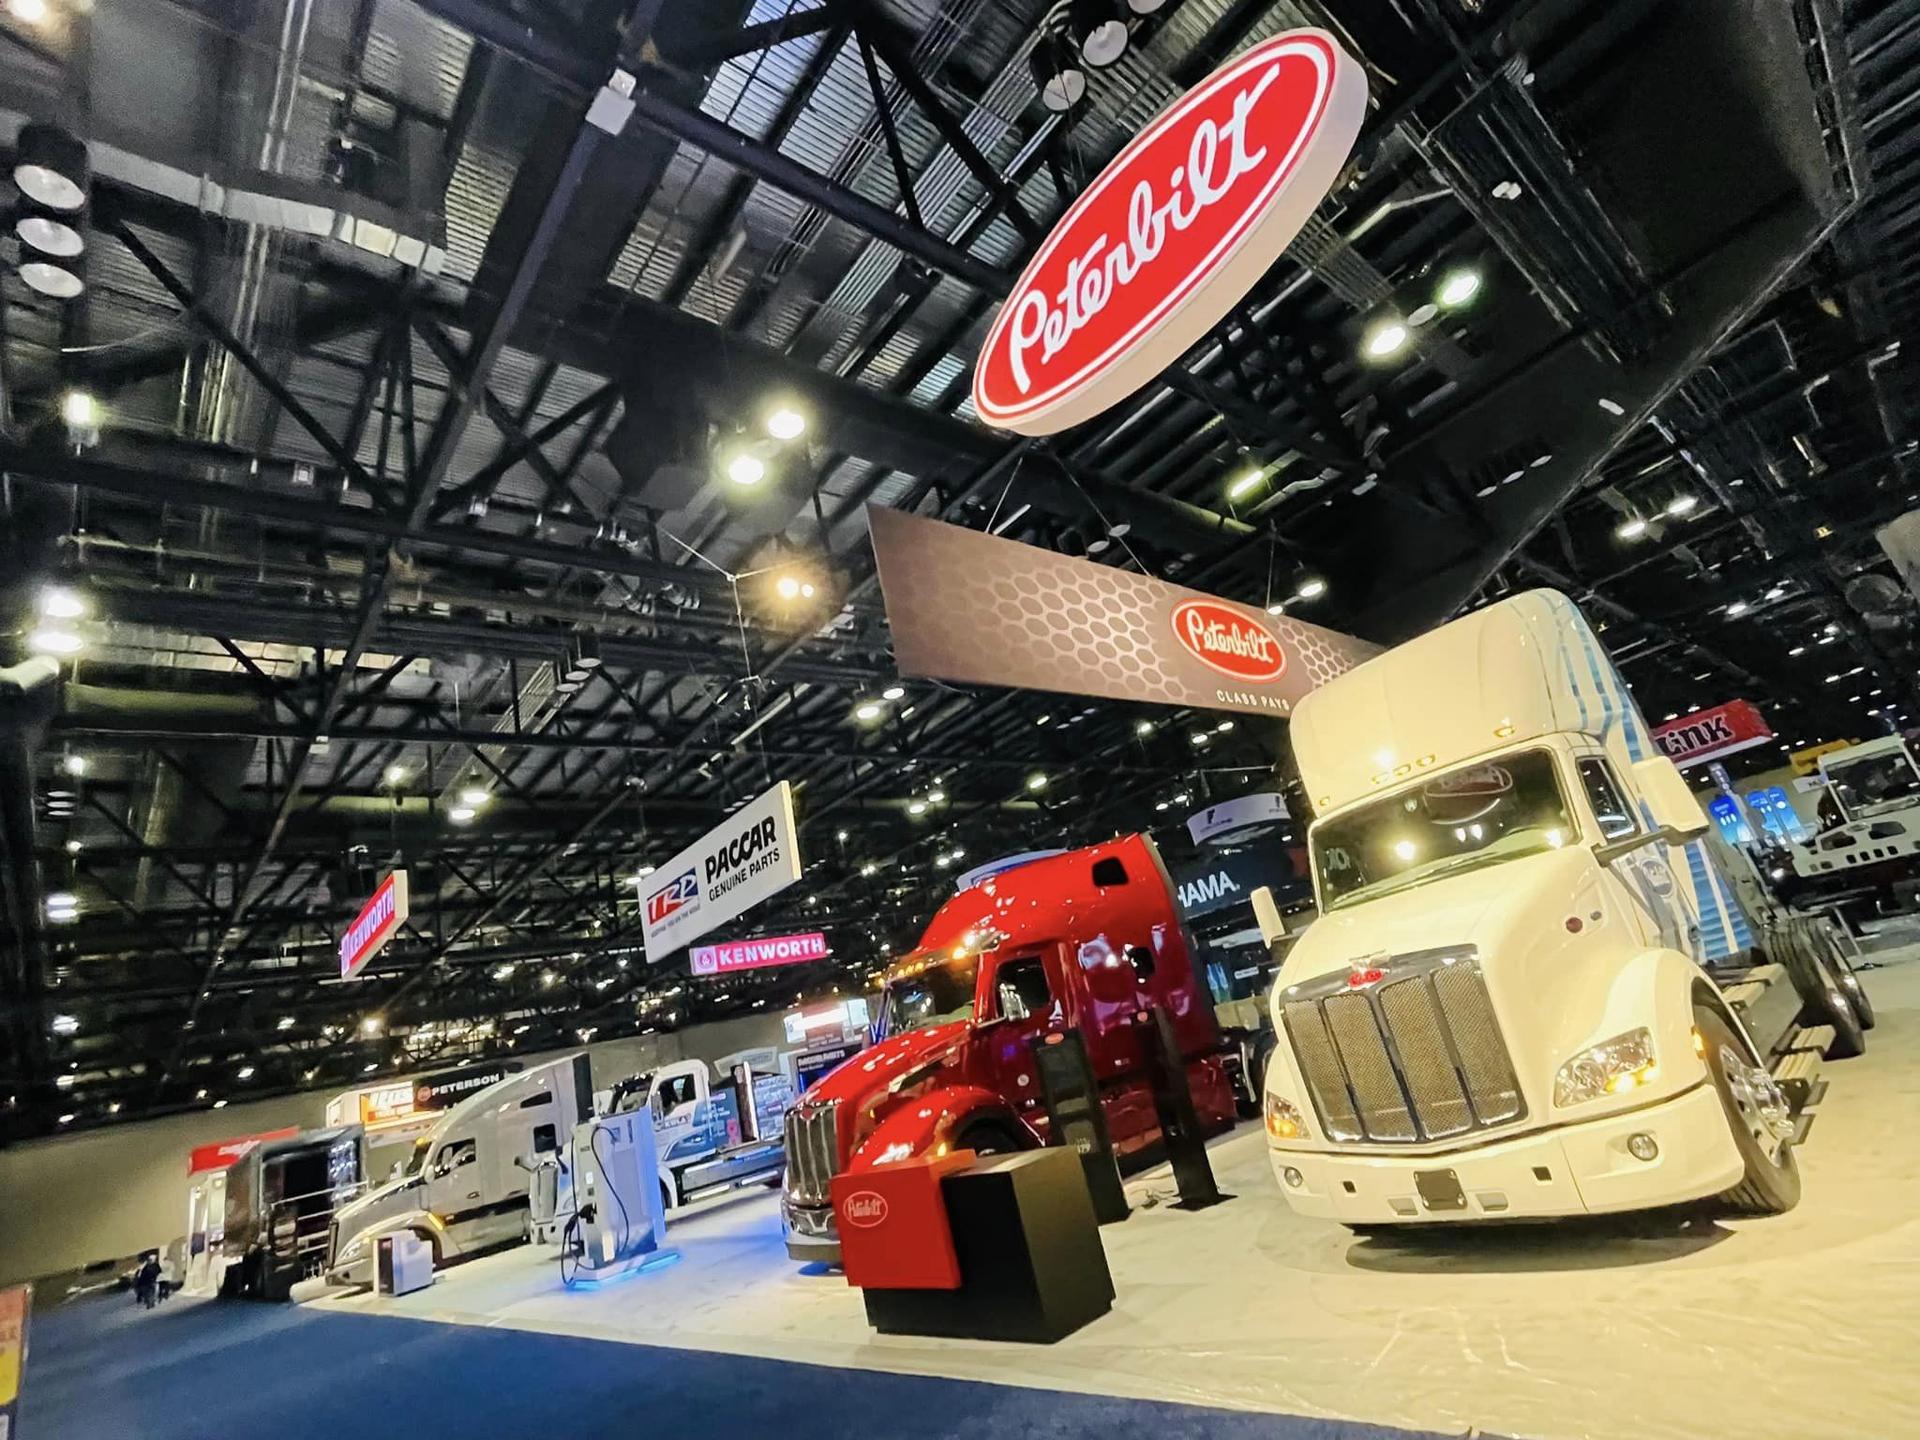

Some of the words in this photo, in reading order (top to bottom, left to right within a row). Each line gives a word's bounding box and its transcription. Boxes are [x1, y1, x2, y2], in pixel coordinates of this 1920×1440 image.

[1010, 63, 1280, 394] Peterbilt
[1187, 609, 1274, 663] Peterbilt
[1216, 689, 1257, 706] CLASS
[1261, 696, 1290, 711] PAYS
[704, 815, 777, 885] PACCAR
[708, 868, 748, 902] GENUINE
[749, 847, 781, 878] PARTS
[349, 883, 394, 963] KENWORTH
[648, 873, 698, 921] TRP
[719, 937, 826, 966] KENWORTH
[432, 1073, 500, 1096] PETERSON
